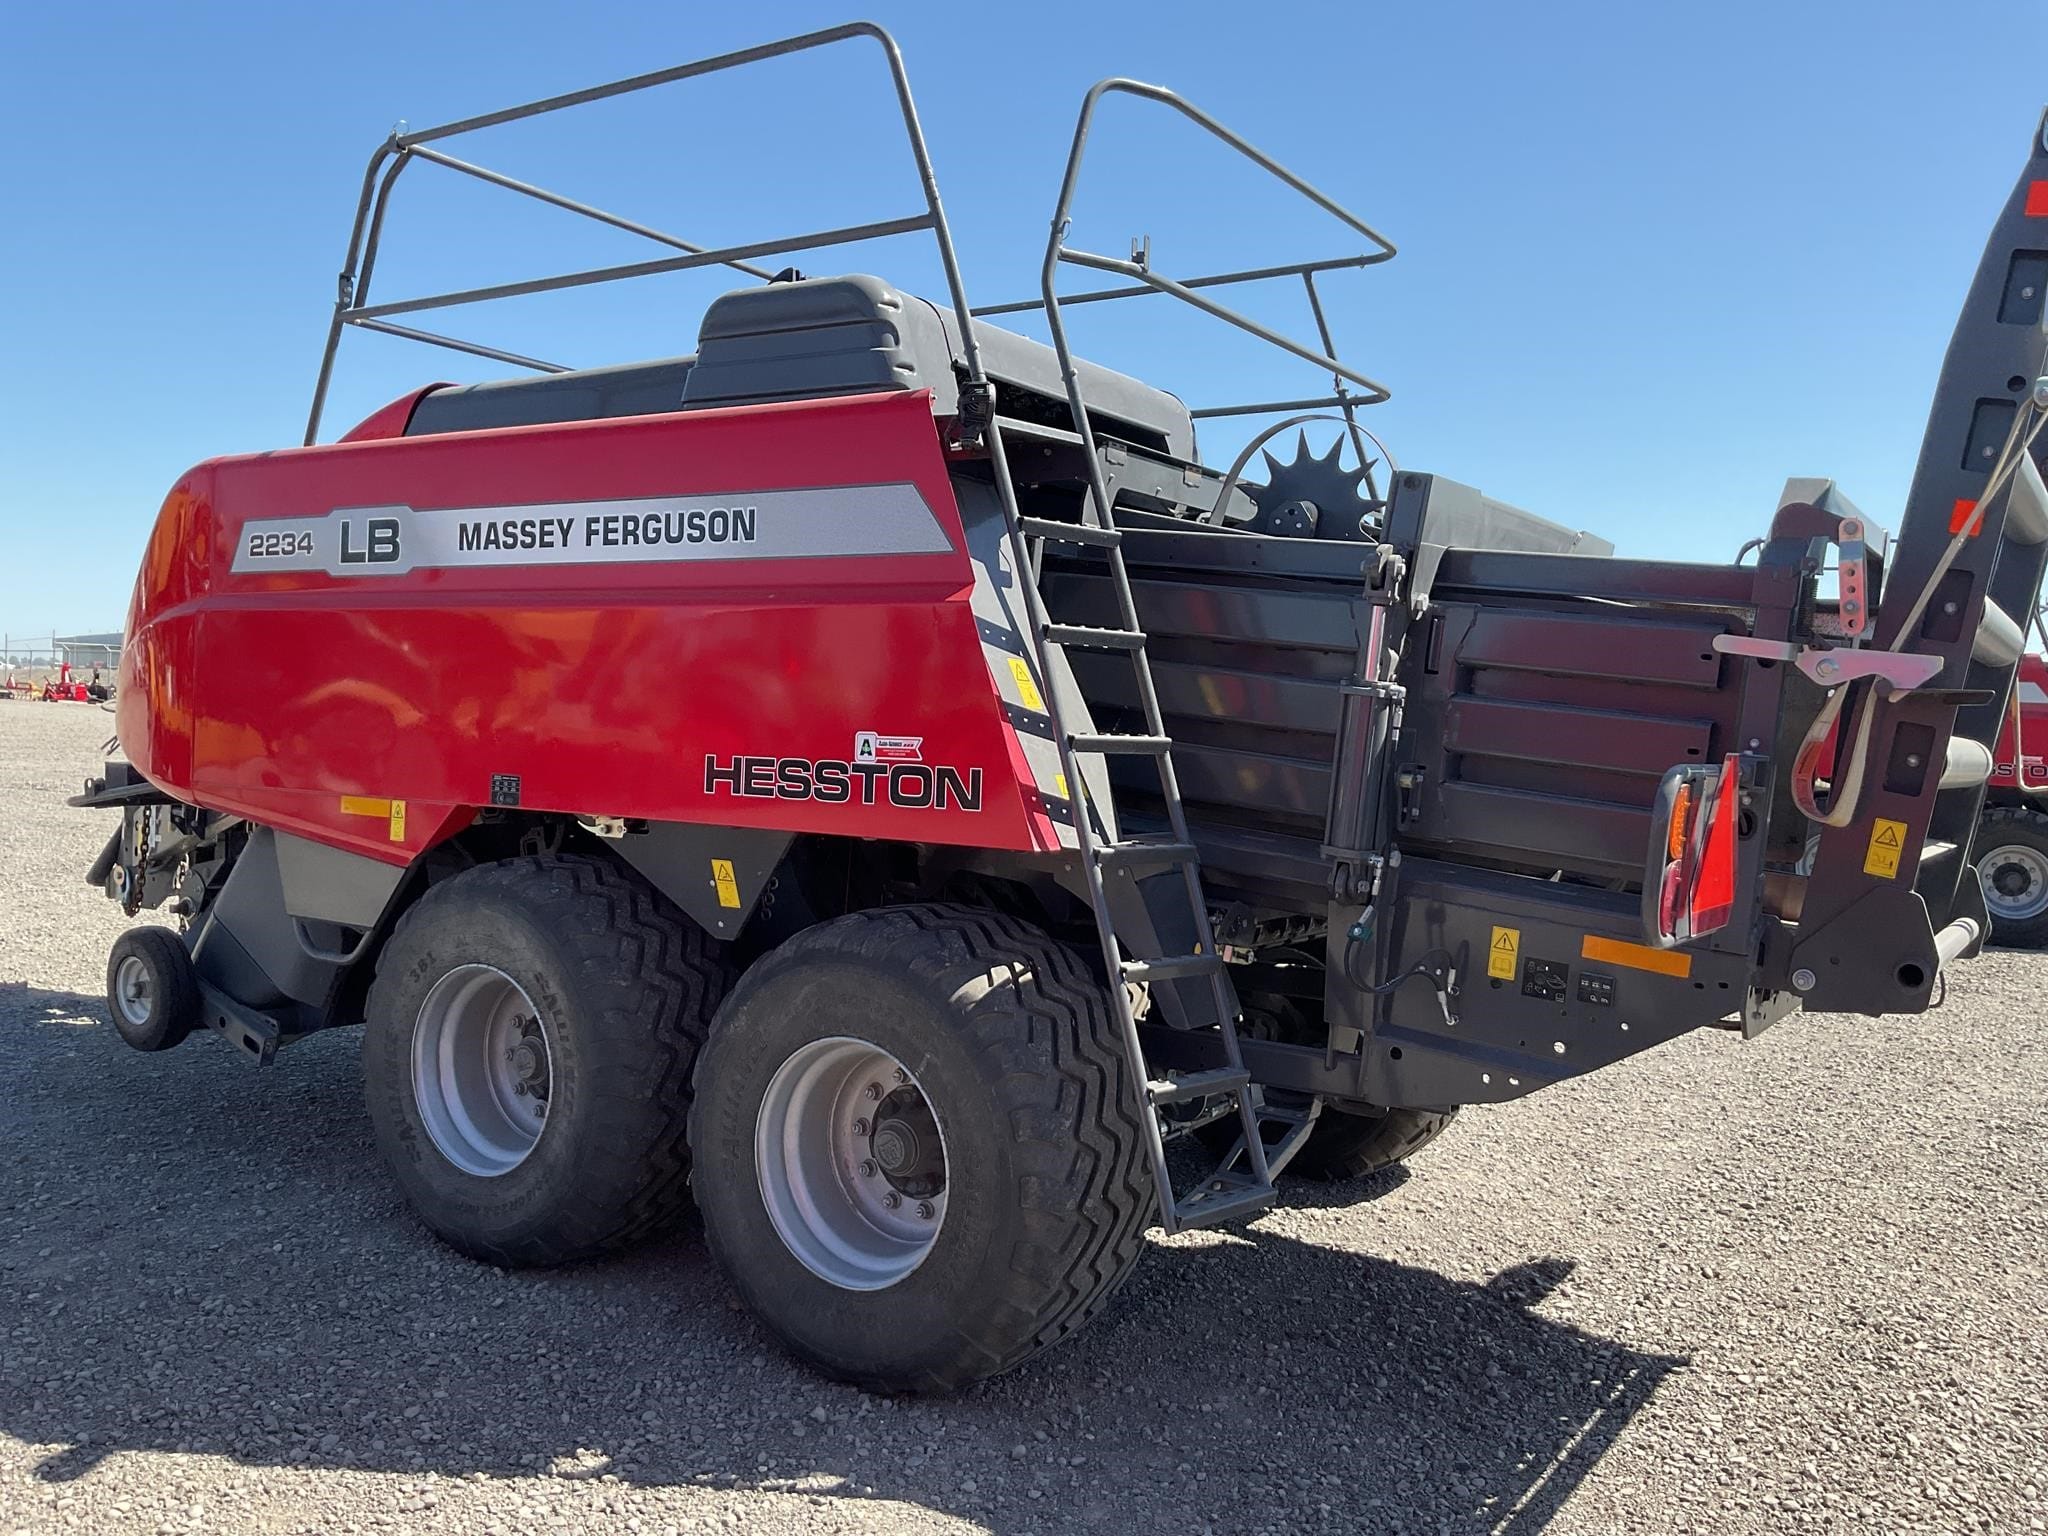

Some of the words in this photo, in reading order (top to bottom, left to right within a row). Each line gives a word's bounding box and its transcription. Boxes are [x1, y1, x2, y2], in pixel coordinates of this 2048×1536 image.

[249, 531, 313, 558] 2234
[339, 517, 401, 565] LB
[458, 517, 575, 551] MASSEY
[585, 507, 756, 547] FERGUSON
[704, 754, 982, 811] HESSTON
